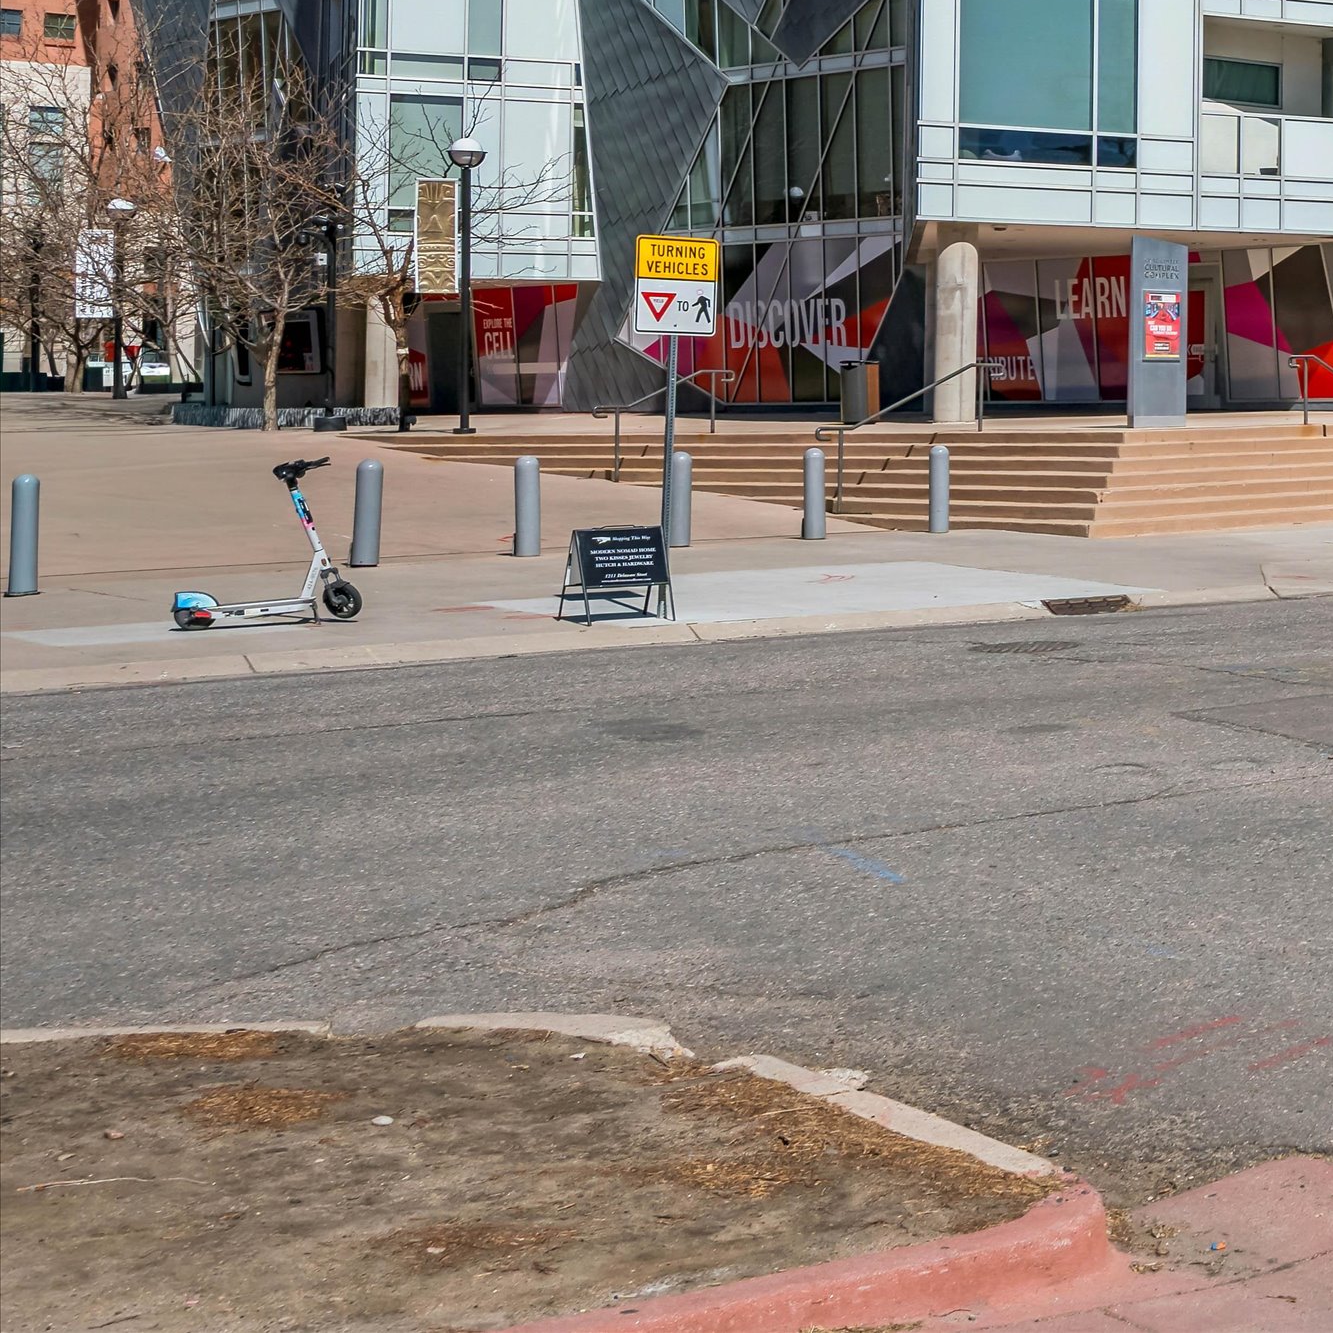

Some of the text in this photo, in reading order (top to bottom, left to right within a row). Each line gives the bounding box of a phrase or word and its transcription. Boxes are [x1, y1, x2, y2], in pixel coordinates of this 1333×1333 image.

[650, 243, 706, 260] TURNING
[646, 260, 708, 276] VEHICLES
[1144, 263, 1180, 272] CULTURAL
[1144, 271, 1180, 280] COMPLEX
[676, 300, 690, 312] TO
[1054, 276, 1127, 320] LEARN
[483, 317, 513, 329] EXPLORE THE
[728, 298, 847, 349] DISCOVER
[484, 331, 515, 360] CELL
